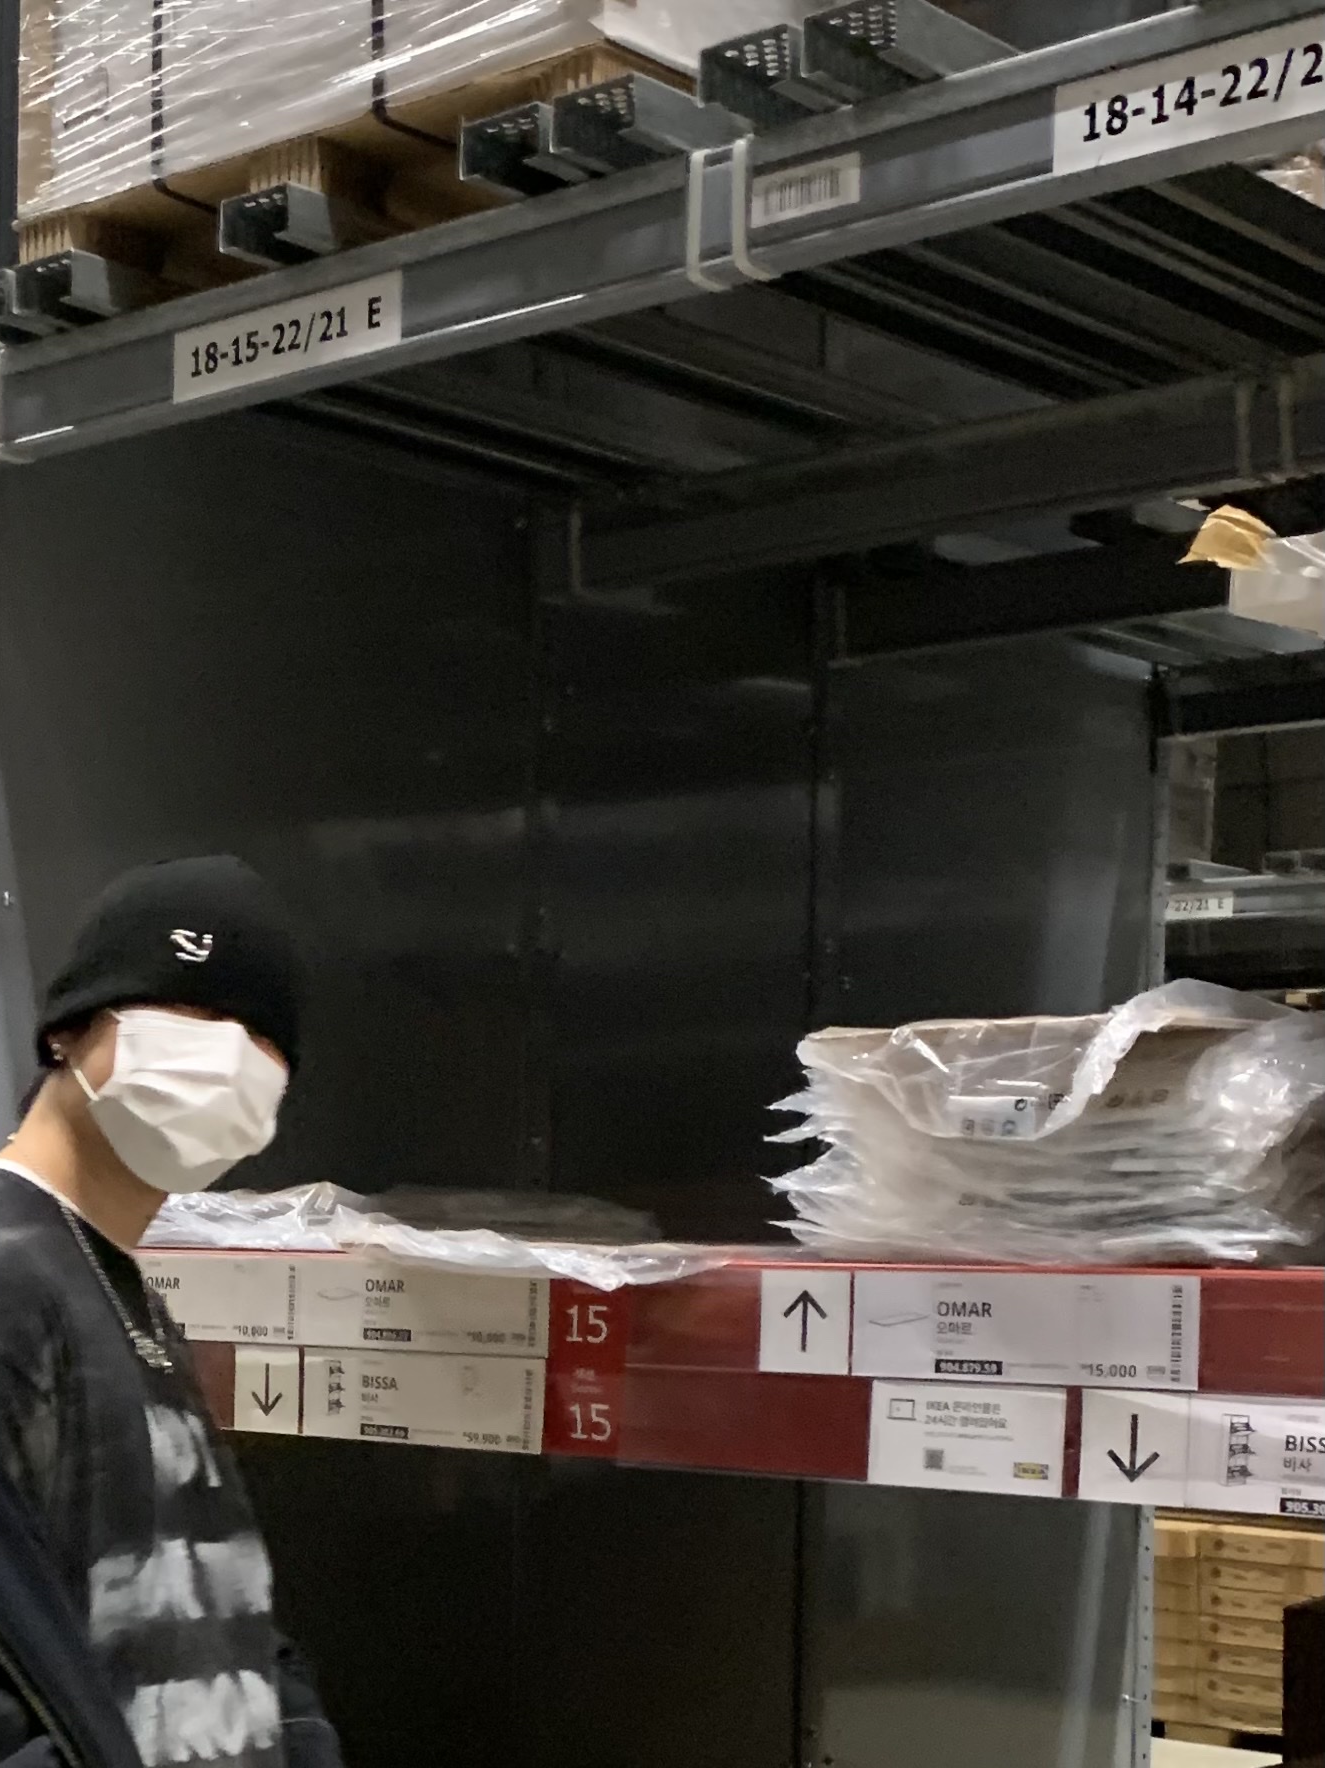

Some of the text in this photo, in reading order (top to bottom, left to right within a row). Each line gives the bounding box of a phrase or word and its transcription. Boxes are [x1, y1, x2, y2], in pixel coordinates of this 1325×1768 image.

[190, 295, 382, 379] 18-15-22/21 E
[364, 1277, 405, 1293] OMAR
[935, 1300, 993, 1319] OMAR
[564, 1304, 610, 1344] 15
[361, 1374, 400, 1392] BISSA
[569, 1403, 613, 1443] 15
[1282, 1456, 1313, 1473] 비사
